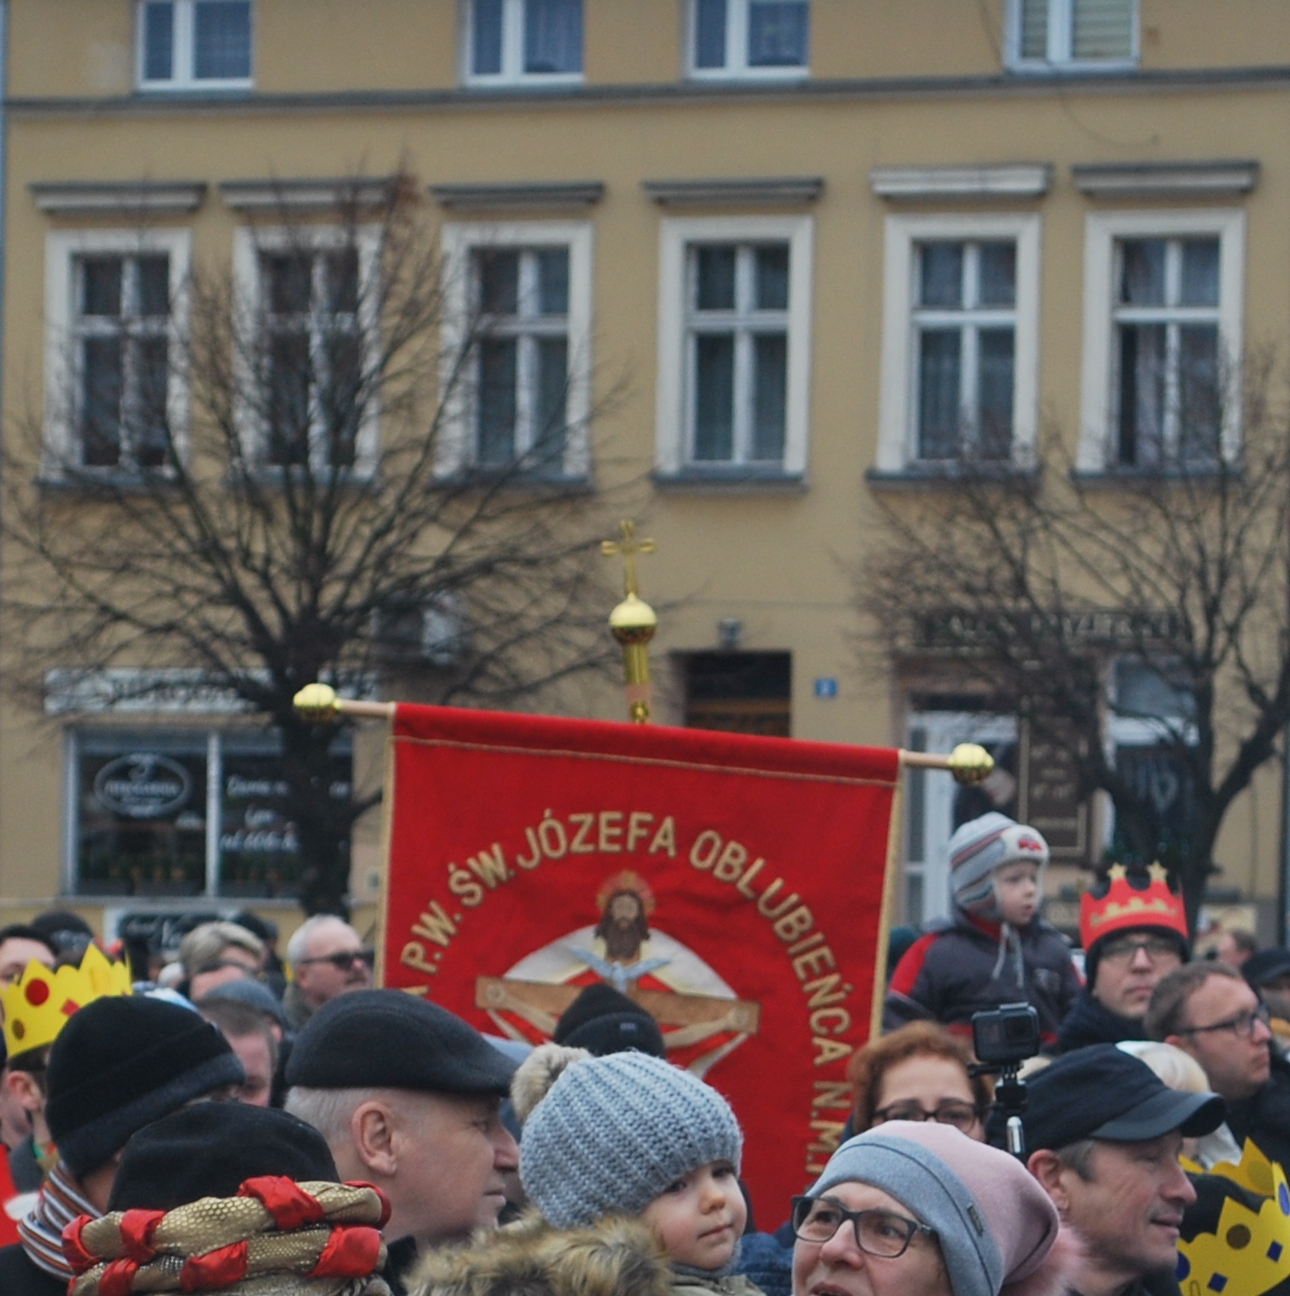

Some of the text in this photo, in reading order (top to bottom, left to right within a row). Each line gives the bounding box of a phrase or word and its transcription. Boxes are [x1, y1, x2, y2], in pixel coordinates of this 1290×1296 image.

[400, 899, 462, 976] P.W.
[447, 841, 517, 908] ŚW.
[516, 807, 678, 871] JÓZEFA
[688, 829, 855, 1068] OBLUBIEŃCA
